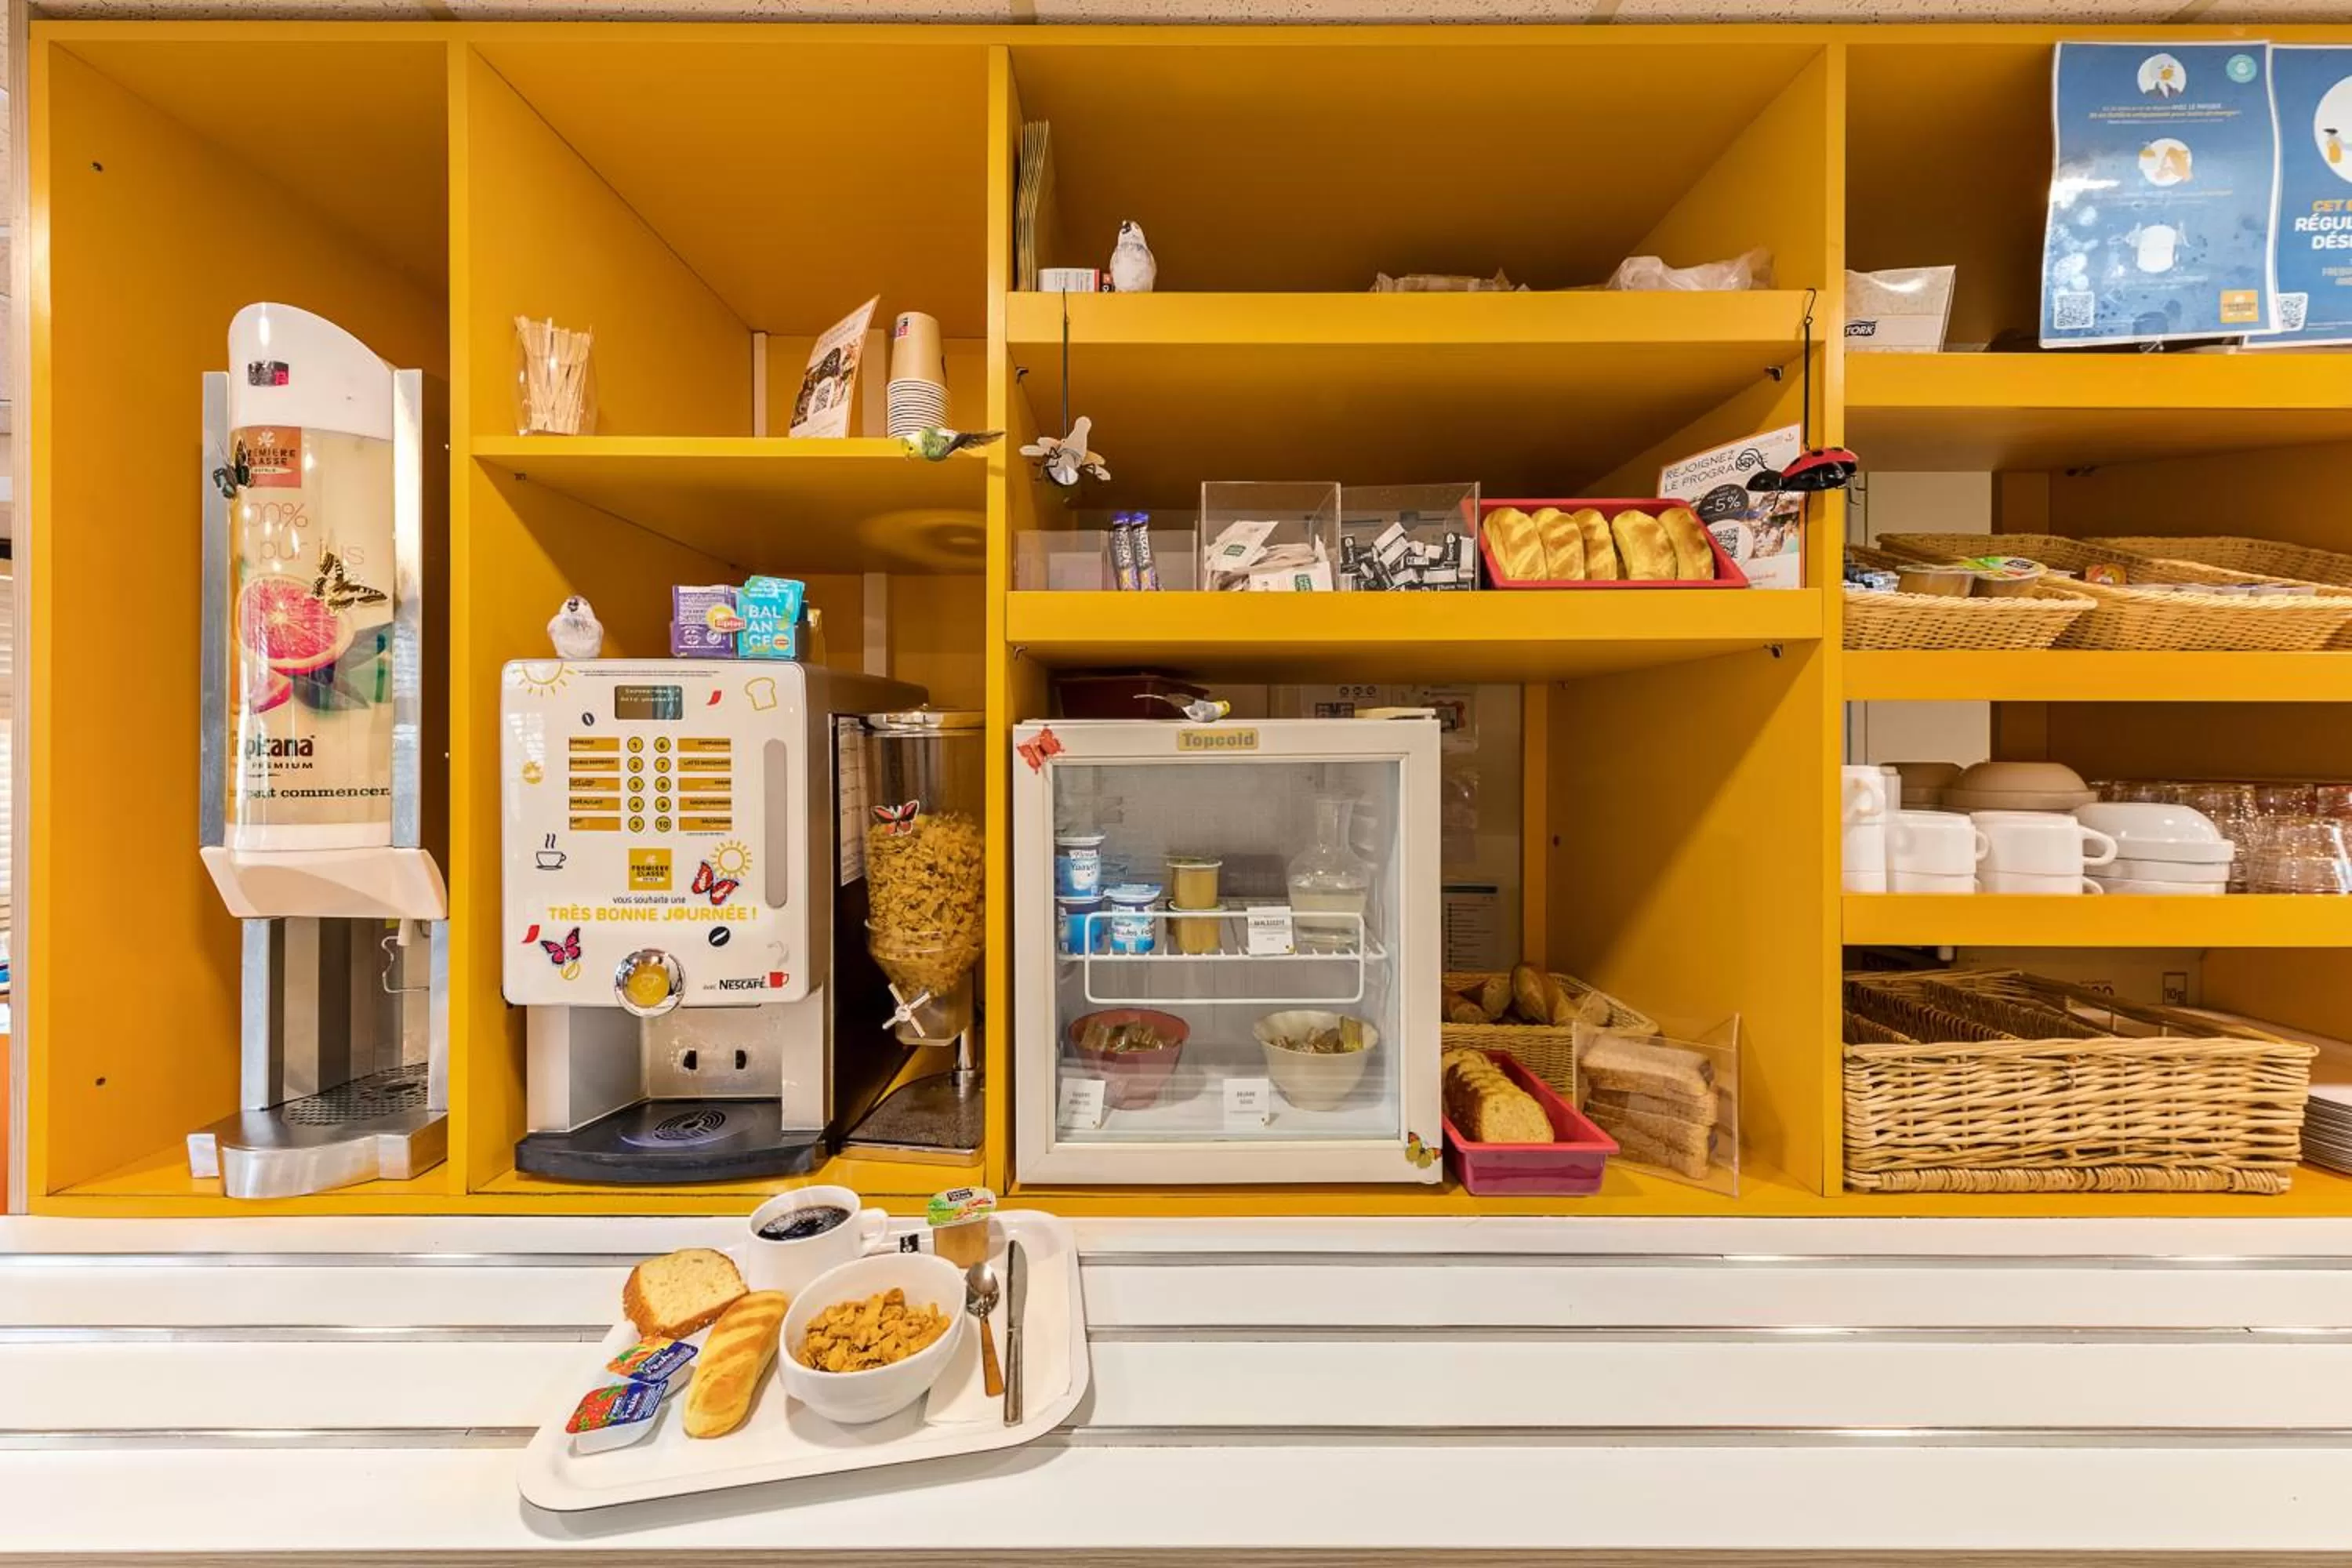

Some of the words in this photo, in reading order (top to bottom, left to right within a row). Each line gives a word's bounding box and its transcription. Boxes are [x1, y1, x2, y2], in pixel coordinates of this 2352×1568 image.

[1846, 325, 1875, 336] TORK
[1664, 480, 1679, 492] LE
[1682, 452, 1769, 489] PROGRAE
[1665, 450, 1735, 480] REJOIGNEZ
[749, 604, 782, 618] BAL
[749, 621, 773, 633] AN
[749, 634, 771, 647] CE
[1181, 731, 1254, 749] Topcold
[281, 787, 390, 797] commencer.
[548, 903, 591, 921] TRÈS
[596, 907, 658, 921] BONNE
[662, 903, 748, 921] JOURNÉE
[719, 975, 766, 990] NESCAFÉ
